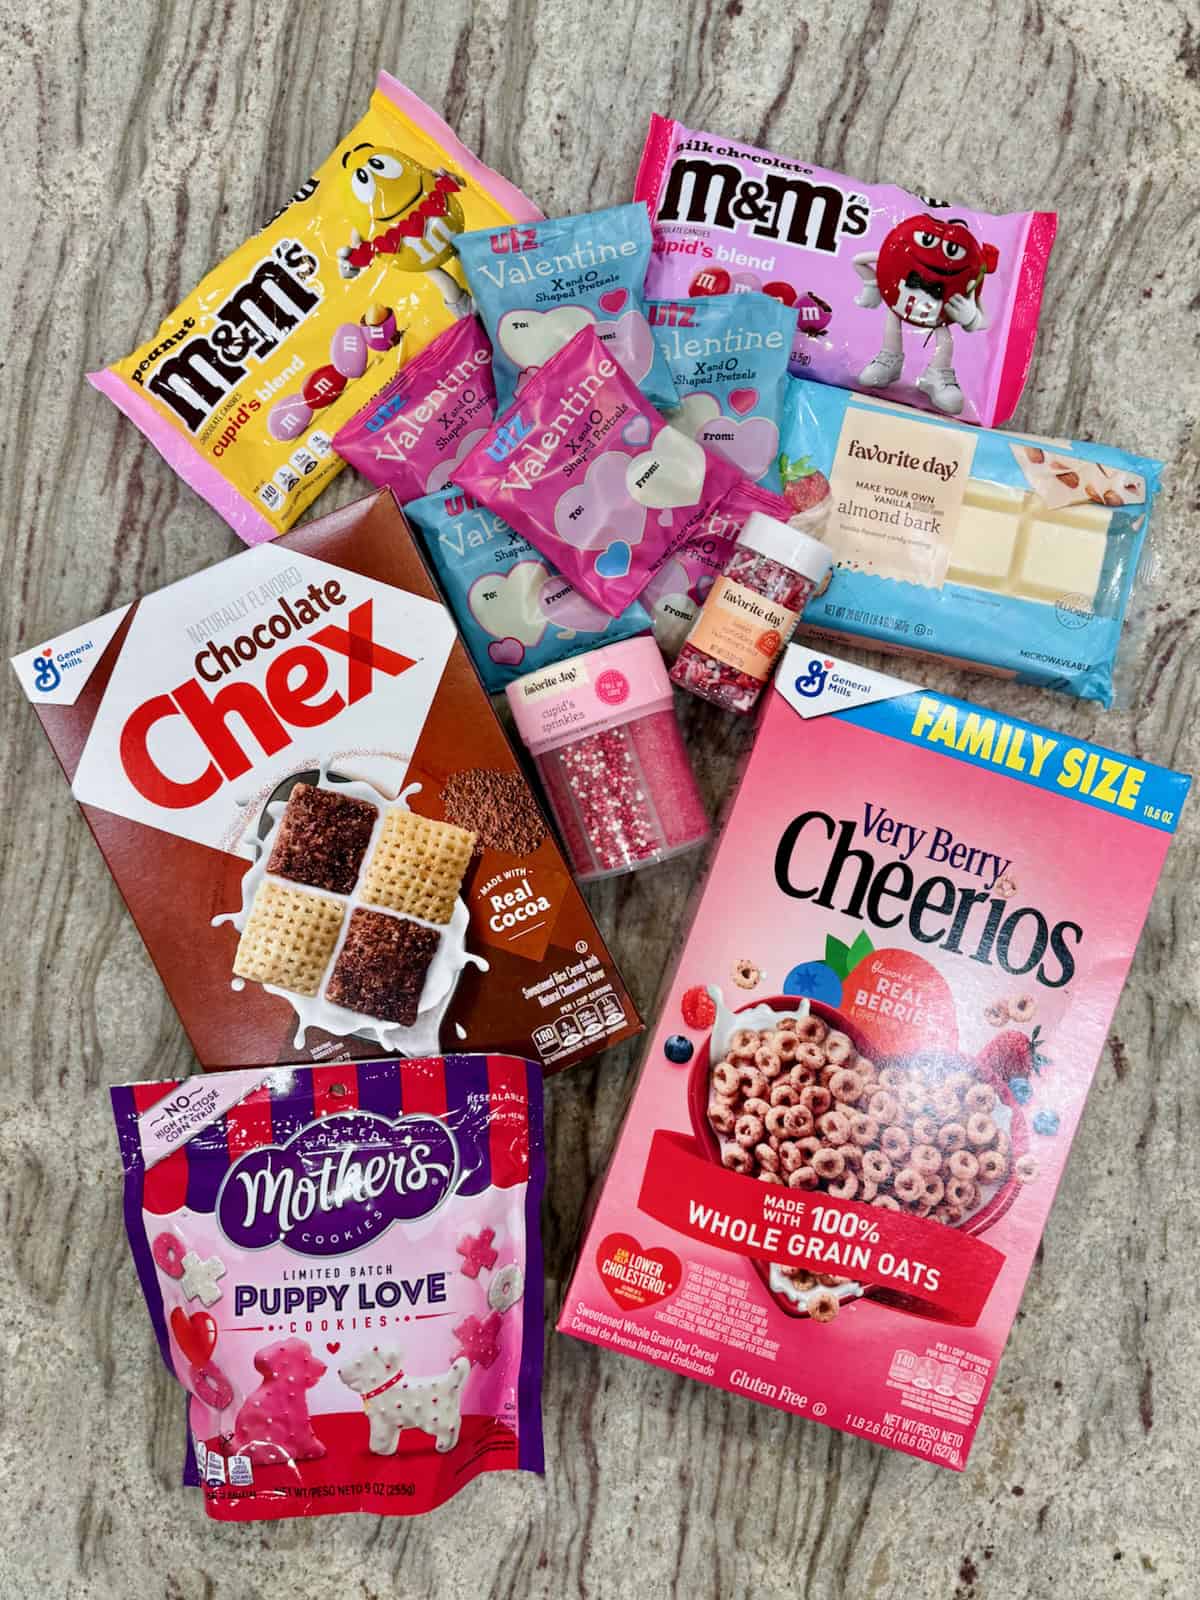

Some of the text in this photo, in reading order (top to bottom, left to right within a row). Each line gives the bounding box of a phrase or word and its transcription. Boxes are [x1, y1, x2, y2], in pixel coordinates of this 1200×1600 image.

[716, 146, 814, 175] chocolate
[489, 227, 538, 254] utz
[477, 240, 638, 289] Valentine
[652, 239, 776, 272] upid's blend
[536, 275, 620, 303] Shaped Pretzels
[551, 279, 565, 291] X
[566, 274, 584, 287] and
[512, 320, 529, 330] To:
[801, 307, 820, 320] m
[131, 316, 196, 387] peanut
[660, 327, 785, 361] alentine
[674, 369, 757, 387] Shaped Pretzels
[694, 362, 707, 376] X
[707, 361, 724, 372] and
[212, 354, 305, 457] cupid's blend
[375, 349, 492, 462] Valentine
[435, 416, 468, 451] Shaped
[438, 413, 454, 431] X
[484, 410, 536, 462] utz
[500, 358, 618, 491] Valentine
[703, 432, 735, 441] From:
[562, 402, 630, 478] Shaped Pretzels
[564, 438, 582, 456] X
[578, 422, 594, 443] and
[635, 461, 661, 488] From:
[848, 440, 959, 482] favorite day
[856, 481, 935, 504] MAKE YOUR OWN
[873, 495, 912, 510] VANILLA
[568, 505, 585, 521] To:
[837, 500, 941, 534] almond bark
[187, 566, 303, 643] NATURALLY FLAVORED
[482, 591, 498, 601] To:
[723, 589, 785, 628] favorite day
[664, 604, 693, 621] From:
[194, 578, 346, 683] Chocolate
[57, 641, 93, 662] General
[61, 657, 82, 671] Mills
[524, 676, 558, 696] favorite
[828, 683, 851, 697] Mills
[831, 673, 872, 694] General
[119, 597, 417, 810] Chex
[542, 700, 576, 719] cupid's
[543, 711, 585, 733] sprinkles
[911, 696, 1147, 810] FAMILY SIZE
[1143, 804, 1174, 825] 18.6 OZ
[863, 802, 1013, 890] Very Berry
[480, 867, 526, 896] MADE WITH
[490, 879, 533, 913] Real
[774, 810, 1084, 988] Cheerios
[489, 896, 551, 932] Cocoa
[876, 977, 925, 1008] REAL
[163, 1096, 189, 1118] NO
[154, 1120, 177, 1140] HIGH
[166, 1122, 191, 1143] CORN
[236, 1136, 448, 1231] Mother's
[763, 1194, 805, 1215] MADE
[763, 1208, 801, 1228] WITH
[301, 1210, 383, 1245] COOKIES
[811, 1206, 881, 1244] 100%
[688, 1200, 942, 1292] WHOLE GRAIN OATS
[283, 1264, 393, 1281] LIMITED BATCH
[629, 1253, 664, 1278] LOWER
[235, 1272, 447, 1317] PUPPY LOVE
[289, 1316, 387, 1333] COOKIES
[576, 1302, 719, 1363] Sweetened Whole Grain Oat Cereal
[571, 1317, 715, 1377] Cereal de Avena Integral Endulzado
[729, 1368, 809, 1409] Gluten Free
[851, 1416, 865, 1429] LB
[865, 1421, 880, 1434] 2.6
[880, 1425, 895, 1440] OZ
[893, 1429, 917, 1447] (18.6
[883, 1412, 964, 1448] NET WT/PESO NETO
[337, 1486, 362, 1498] NETO
[373, 1483, 385, 1495] OZ
